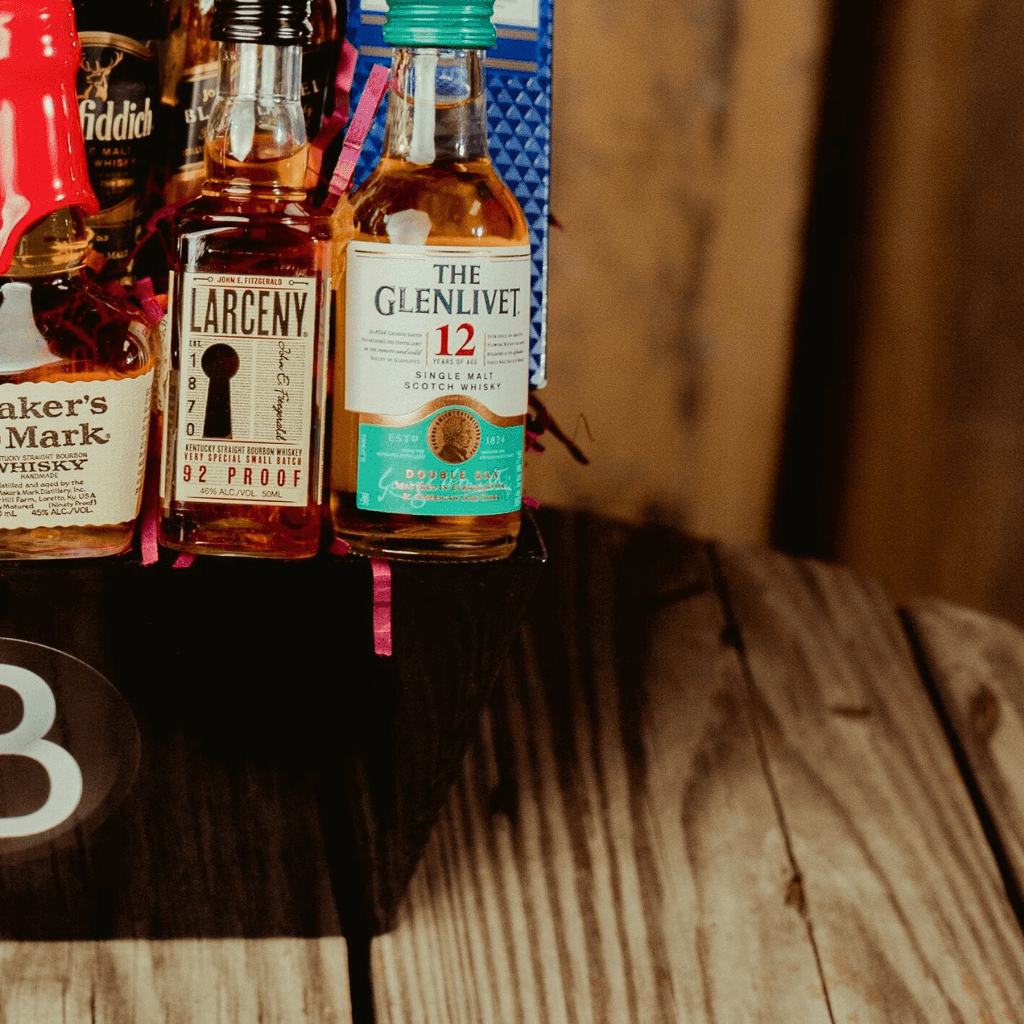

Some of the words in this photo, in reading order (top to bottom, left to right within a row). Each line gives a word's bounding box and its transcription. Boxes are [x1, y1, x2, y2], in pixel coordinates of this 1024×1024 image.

[80, 97, 153, 142] fiddich
[433, 264, 480, 284] THE
[375, 285, 520, 317] GLENLIVET
[190, 288, 307, 337] LARCENY
[435, 322, 476, 357] 12
[416, 371, 461, 380] SINGLE
[467, 372, 494, 380] MALT
[404, 382, 454, 391] SCOTCH
[461, 383, 501, 391] WHISKY
[5, 423, 110, 449] Mark
[388, 433, 419, 443] ESTD
[485, 435, 505, 445] 1824
[186, 444, 215, 453] KENTUCKY
[217, 445, 245, 454] STRAIGHT
[247, 446, 275, 455] BOURBON
[276, 448, 302, 456] WHISKEY
[184, 452, 204, 461] VERY
[208, 454, 241, 463] SPECIAL
[246, 456, 272, 464] SMALL
[276, 456, 302, 466] BATCH
[21, 472, 58, 480] HANDMADE
[183, 464, 207, 482] 92
[228, 466, 301, 487] PROOF
[40, 481, 58, 489] aged
[60, 480, 69, 488] by
[200, 487, 217, 495] 46%
